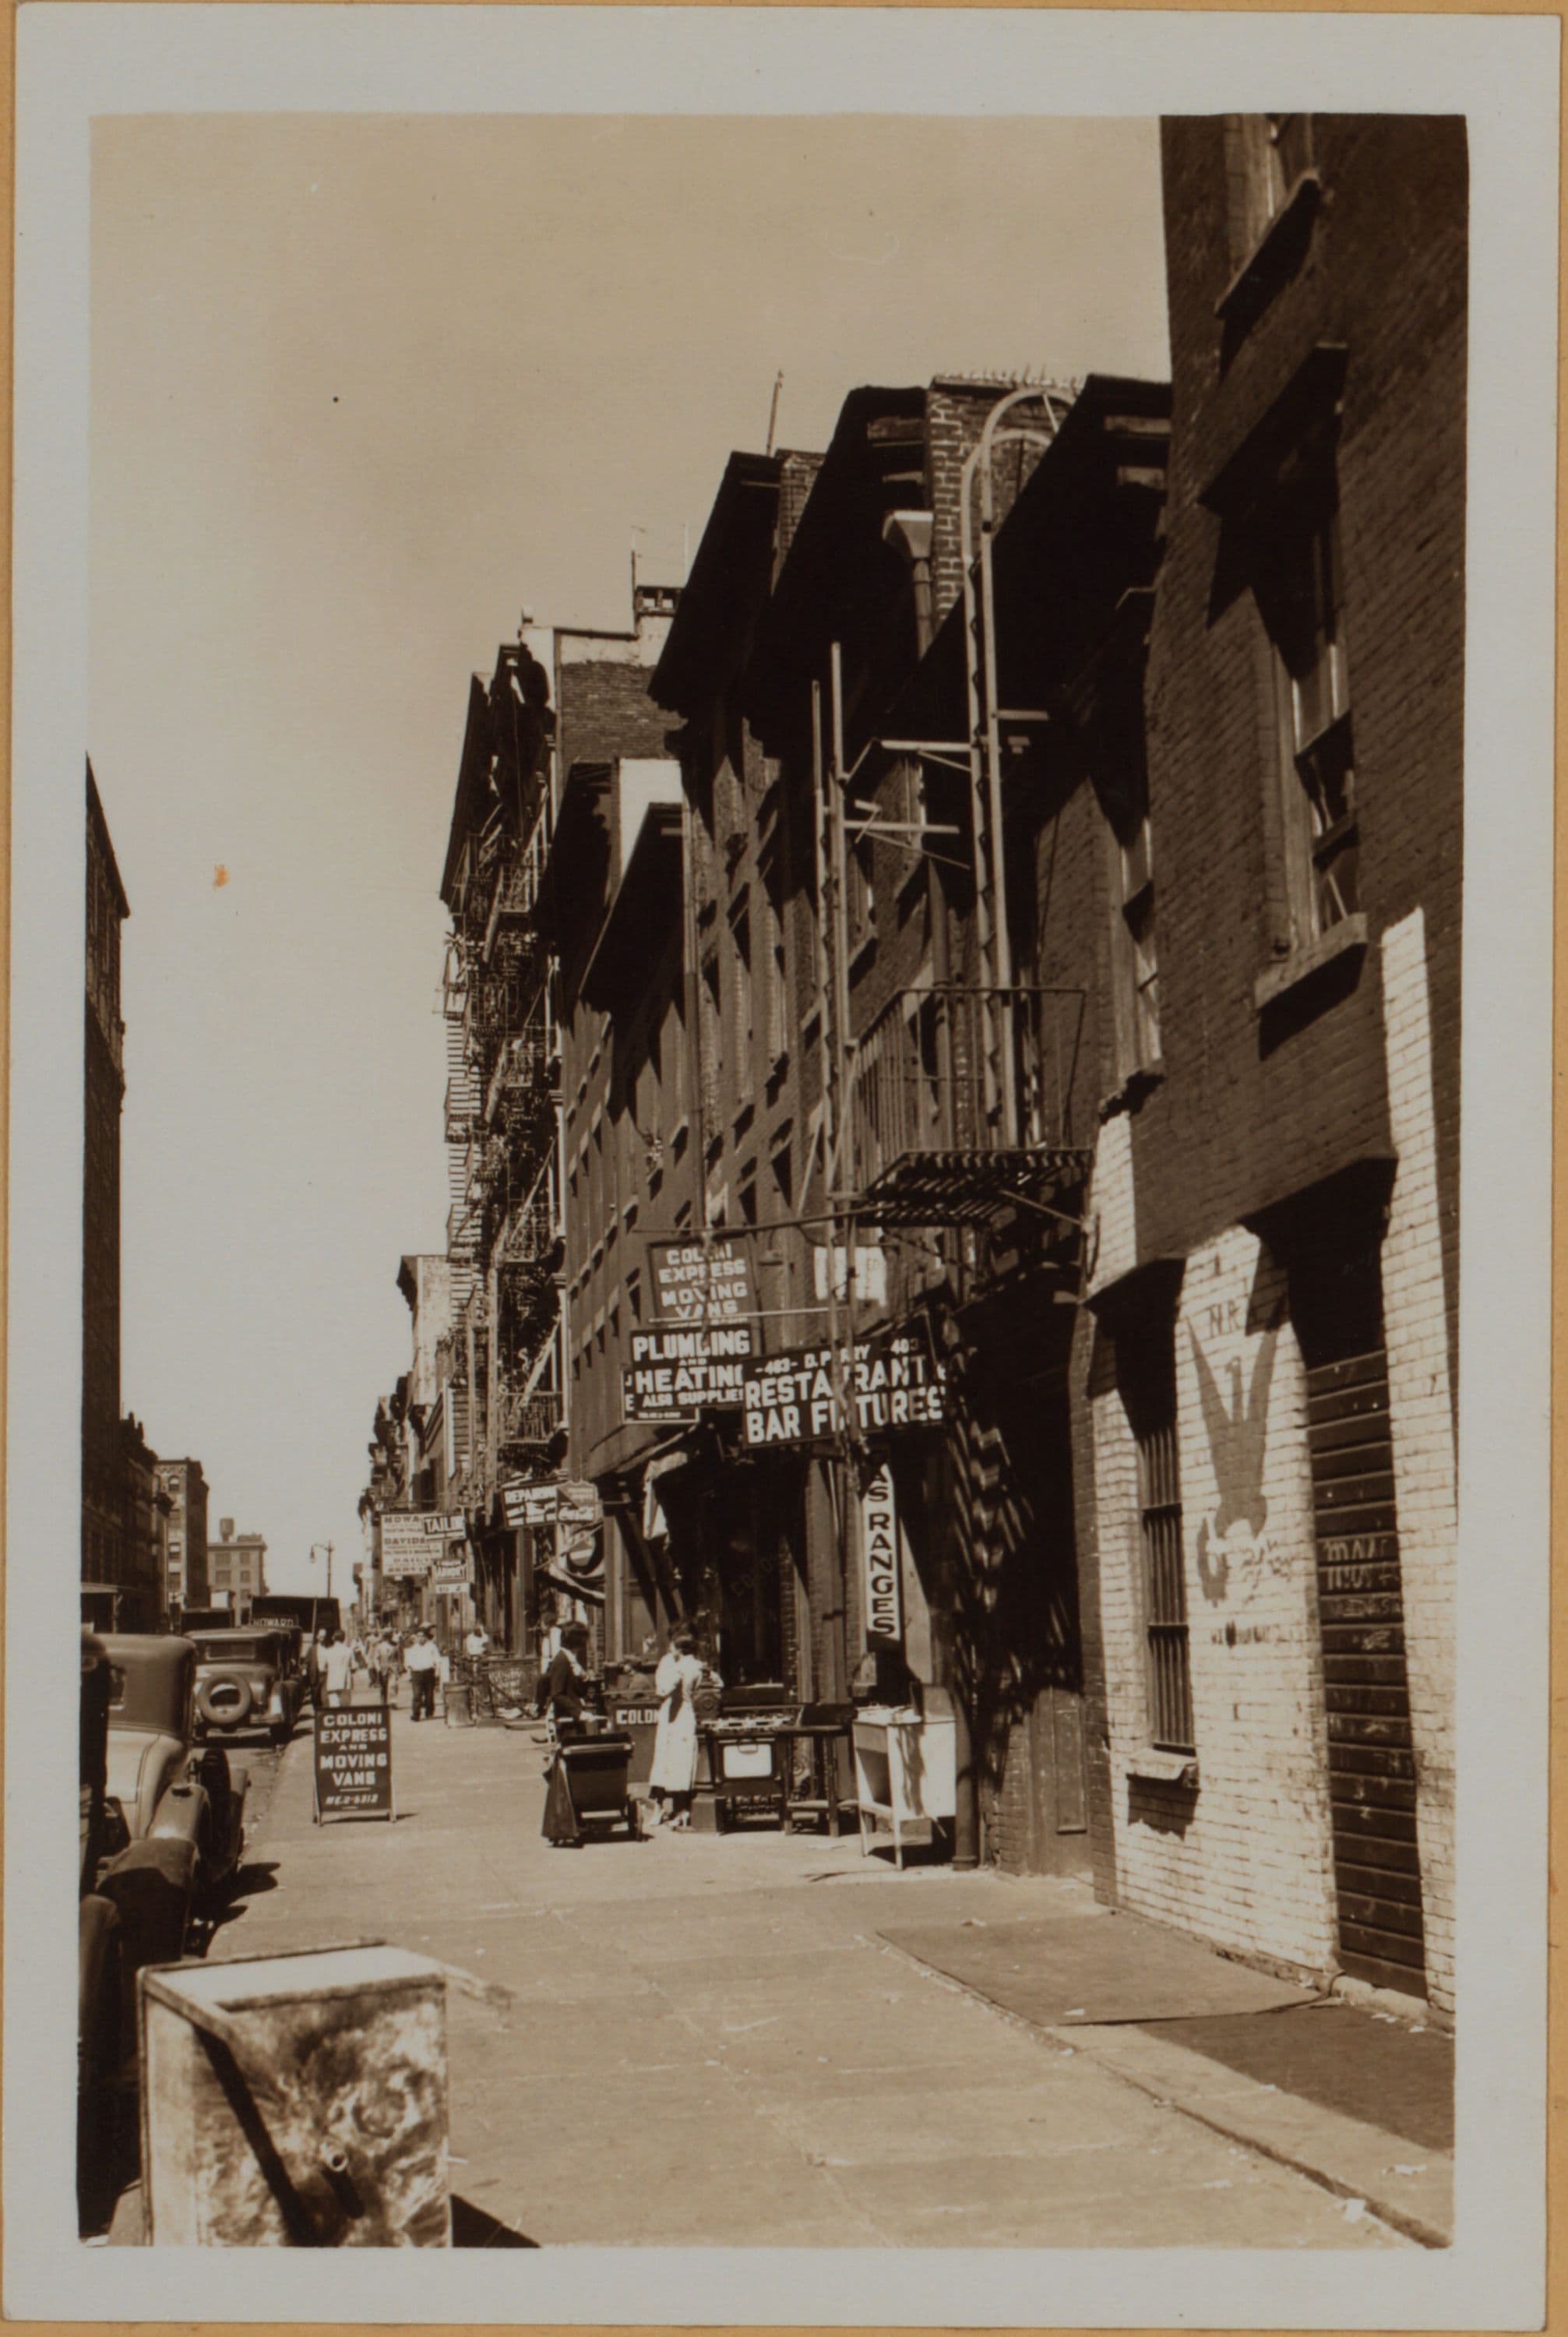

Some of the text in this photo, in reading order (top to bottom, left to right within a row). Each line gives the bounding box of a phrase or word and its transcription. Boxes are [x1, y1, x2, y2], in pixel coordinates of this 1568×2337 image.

[632, 1329, 749, 1362] PLUMBING
[642, 1394, 673, 1408] ALSO
[746, 1386, 946, 1443] BAR FITURES
[869, 1513, 895, 1634] RANGES
[320, 1728, 388, 1743] EXPRESS
[320, 1754, 388, 1770] MOVING
[333, 1771, 376, 1787] VANS
